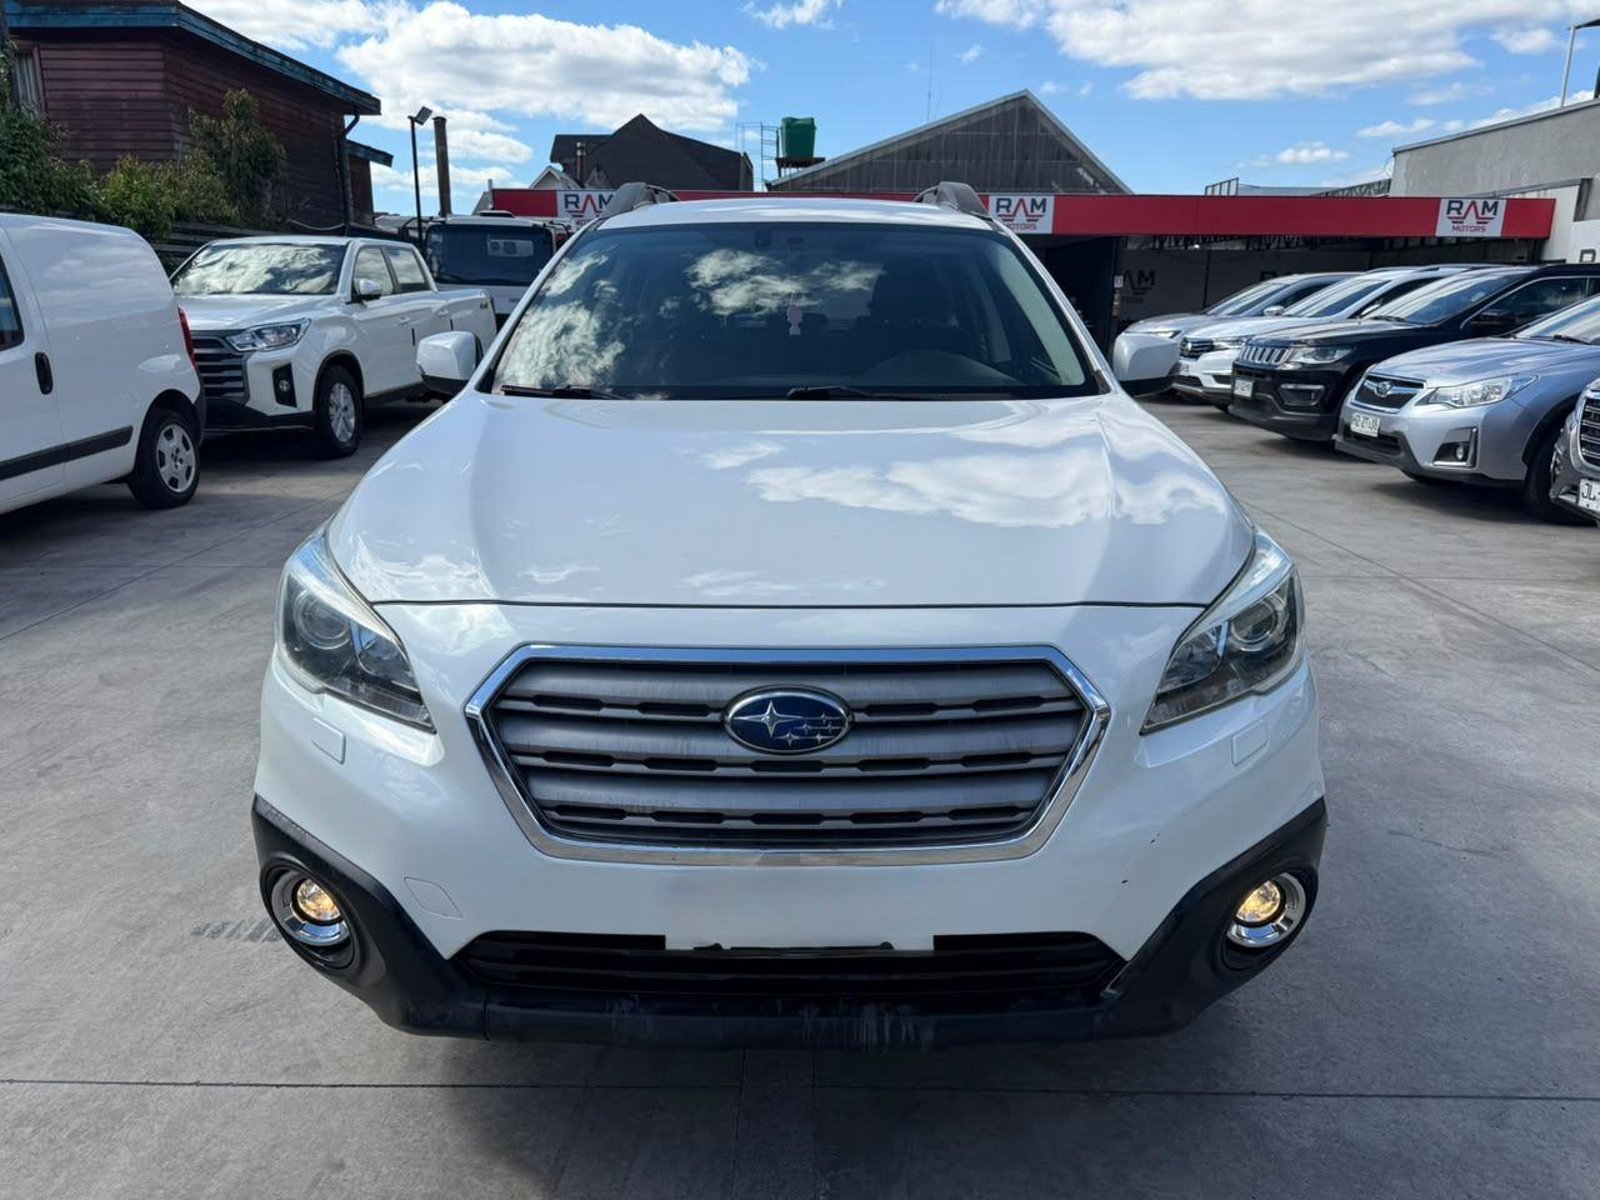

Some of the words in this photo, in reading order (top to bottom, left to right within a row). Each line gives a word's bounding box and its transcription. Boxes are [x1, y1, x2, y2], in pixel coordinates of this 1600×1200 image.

[564, 193, 613, 212] RAM
[996, 197, 1047, 217] RAM
[1446, 199, 1499, 219] RAM
[1451, 225, 1487, 233] MOTORS
[1119, 269, 1156, 290] AM
